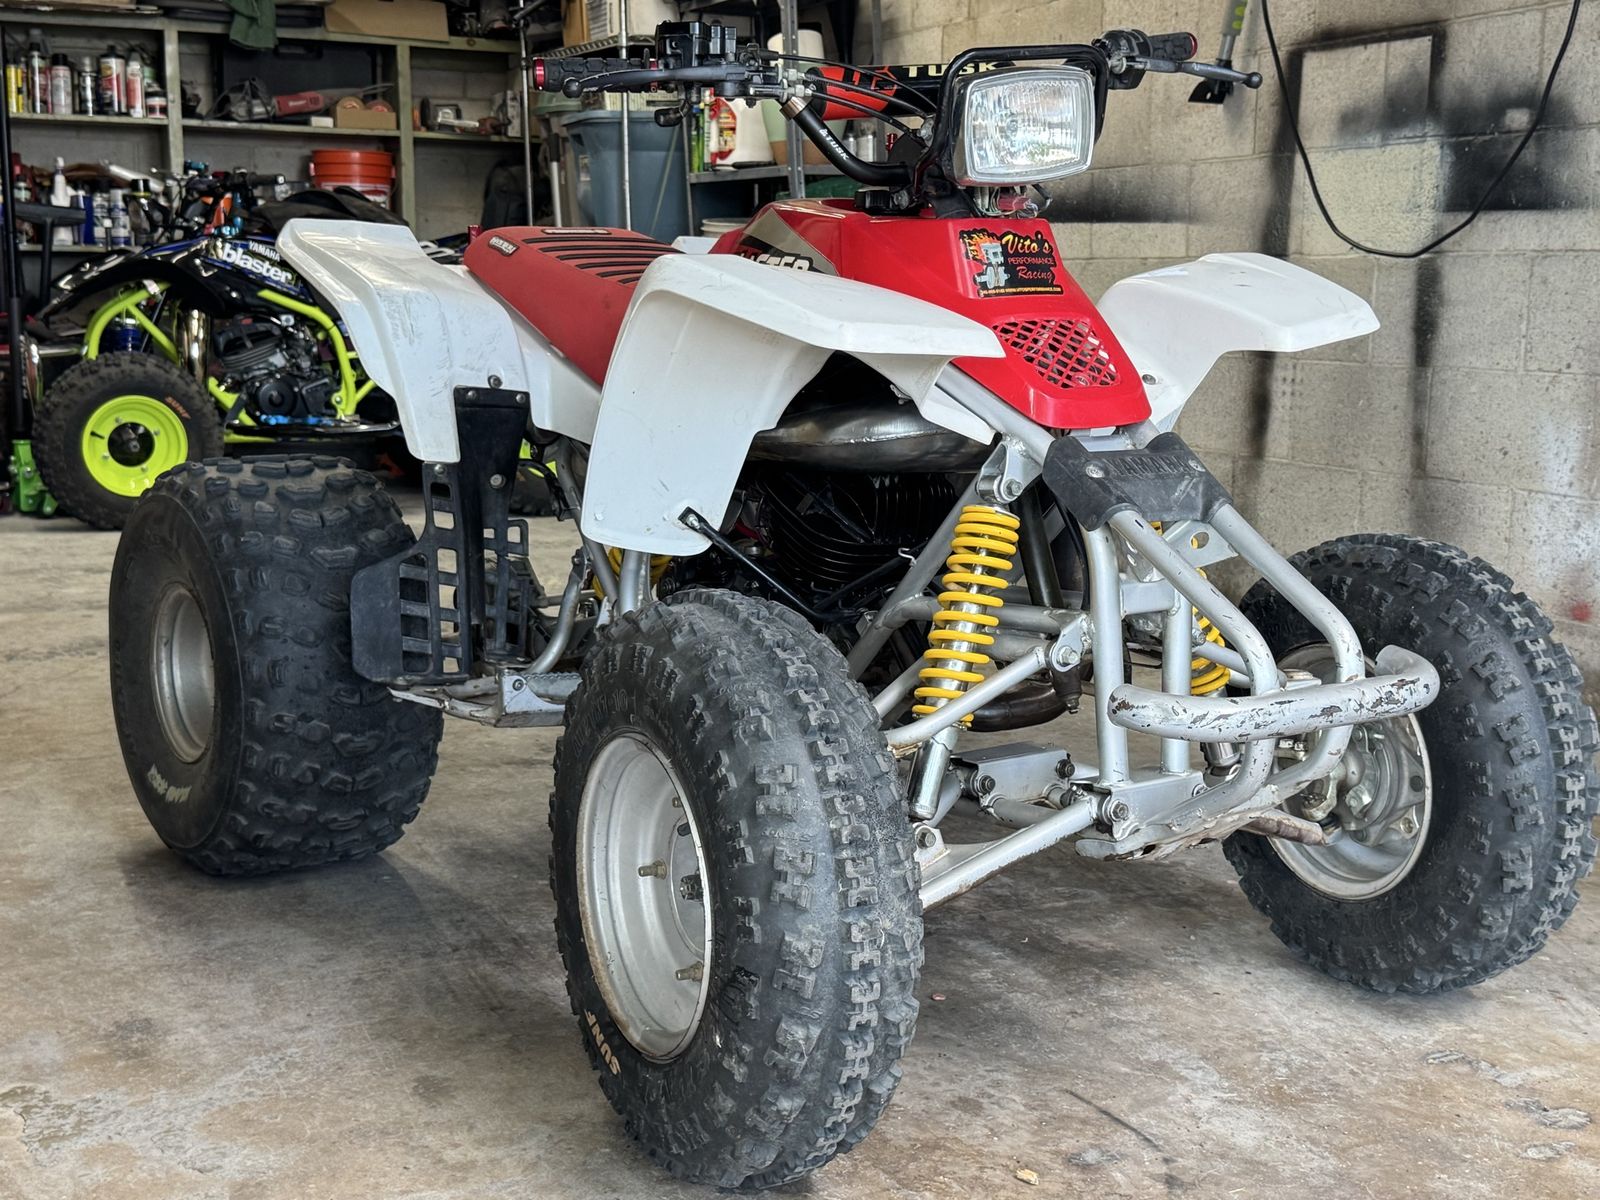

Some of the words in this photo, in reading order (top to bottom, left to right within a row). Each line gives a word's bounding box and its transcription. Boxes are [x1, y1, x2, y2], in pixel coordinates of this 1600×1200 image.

[902, 61, 998, 78] TUSK
[826, 135, 850, 161] TUSK
[248, 240, 281, 262] YAMAHA
[1002, 233, 1052, 255] Vito's
[222, 242, 293, 283] blaster
[1008, 256, 1055, 265] PERFORMANCE
[1016, 265, 1053, 283] Racing
[584, 1008, 622, 1076] SUNF
